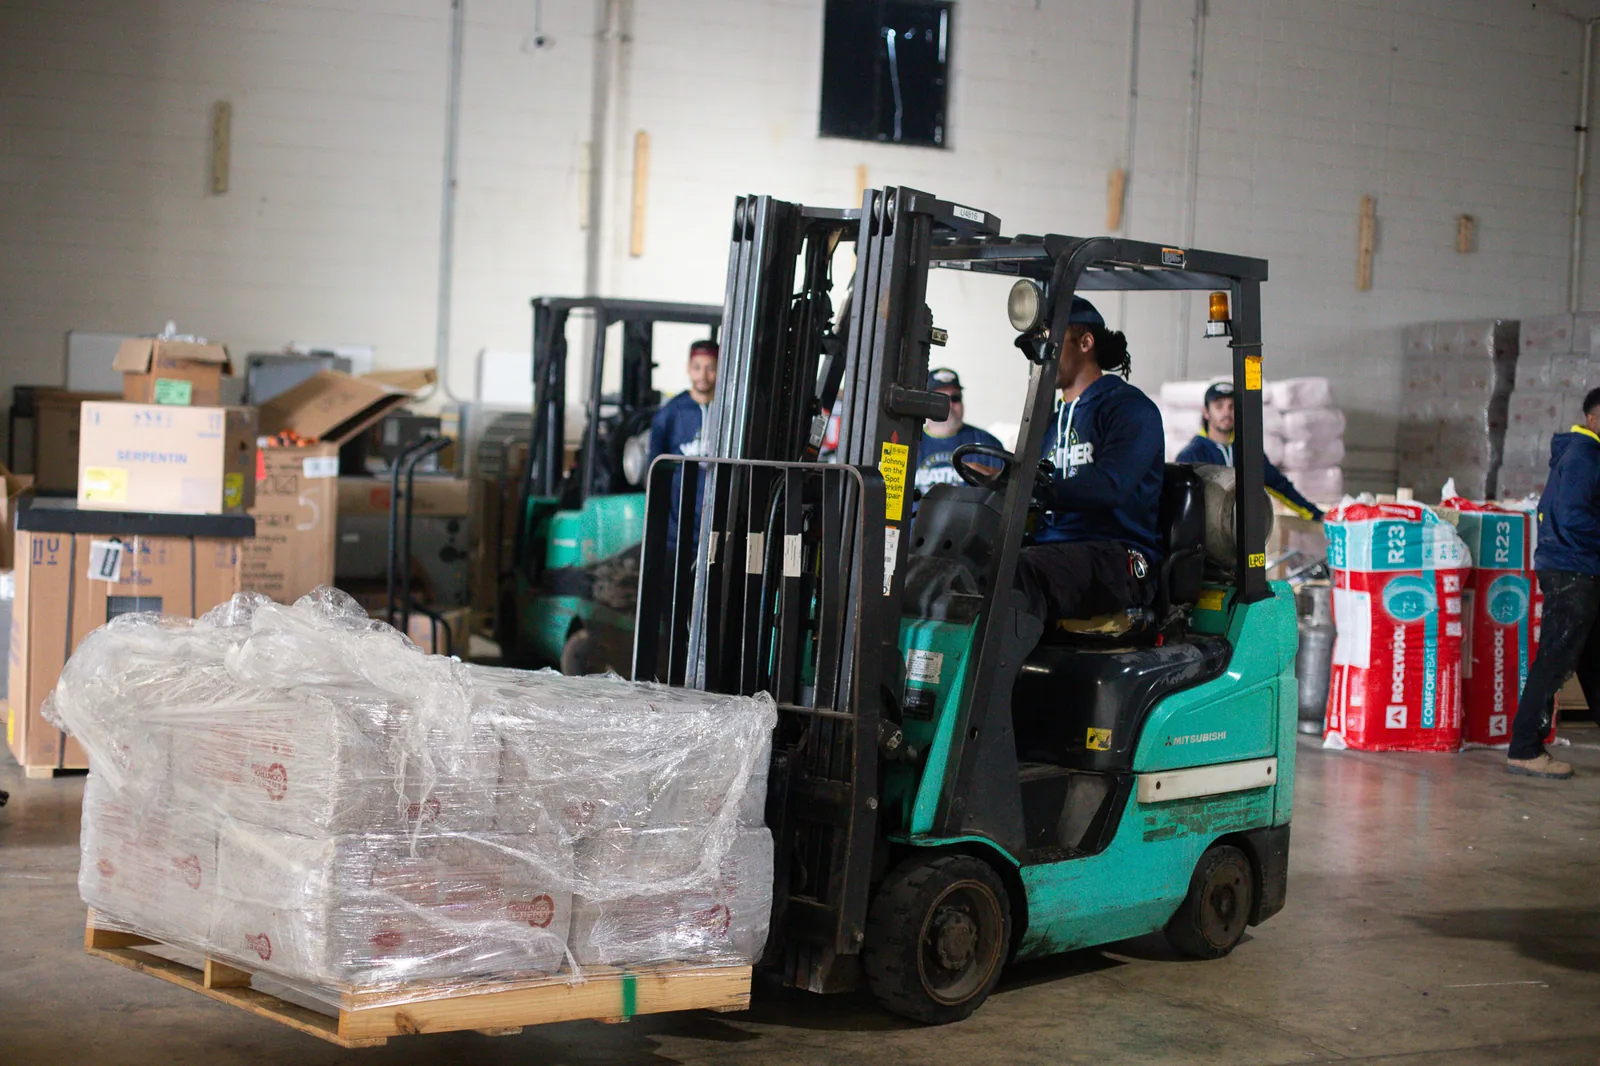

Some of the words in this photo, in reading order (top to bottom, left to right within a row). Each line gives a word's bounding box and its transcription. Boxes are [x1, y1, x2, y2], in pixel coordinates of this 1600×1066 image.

[116, 450, 188, 464] SERPENTIN
[883, 456, 906, 468] Johnny
[1049, 442, 1094, 468] THER
[893, 466, 903, 475] the
[885, 474, 900, 483] Spot
[886, 484, 903, 492] orklift
[1388, 525, 1406, 563] R23
[1495, 521, 1510, 562] R23
[1249, 555, 1264, 567] LPG
[1494, 628, 1504, 712] ROCKWOOL
[1173, 731, 1227, 746] MITSUBISHI
